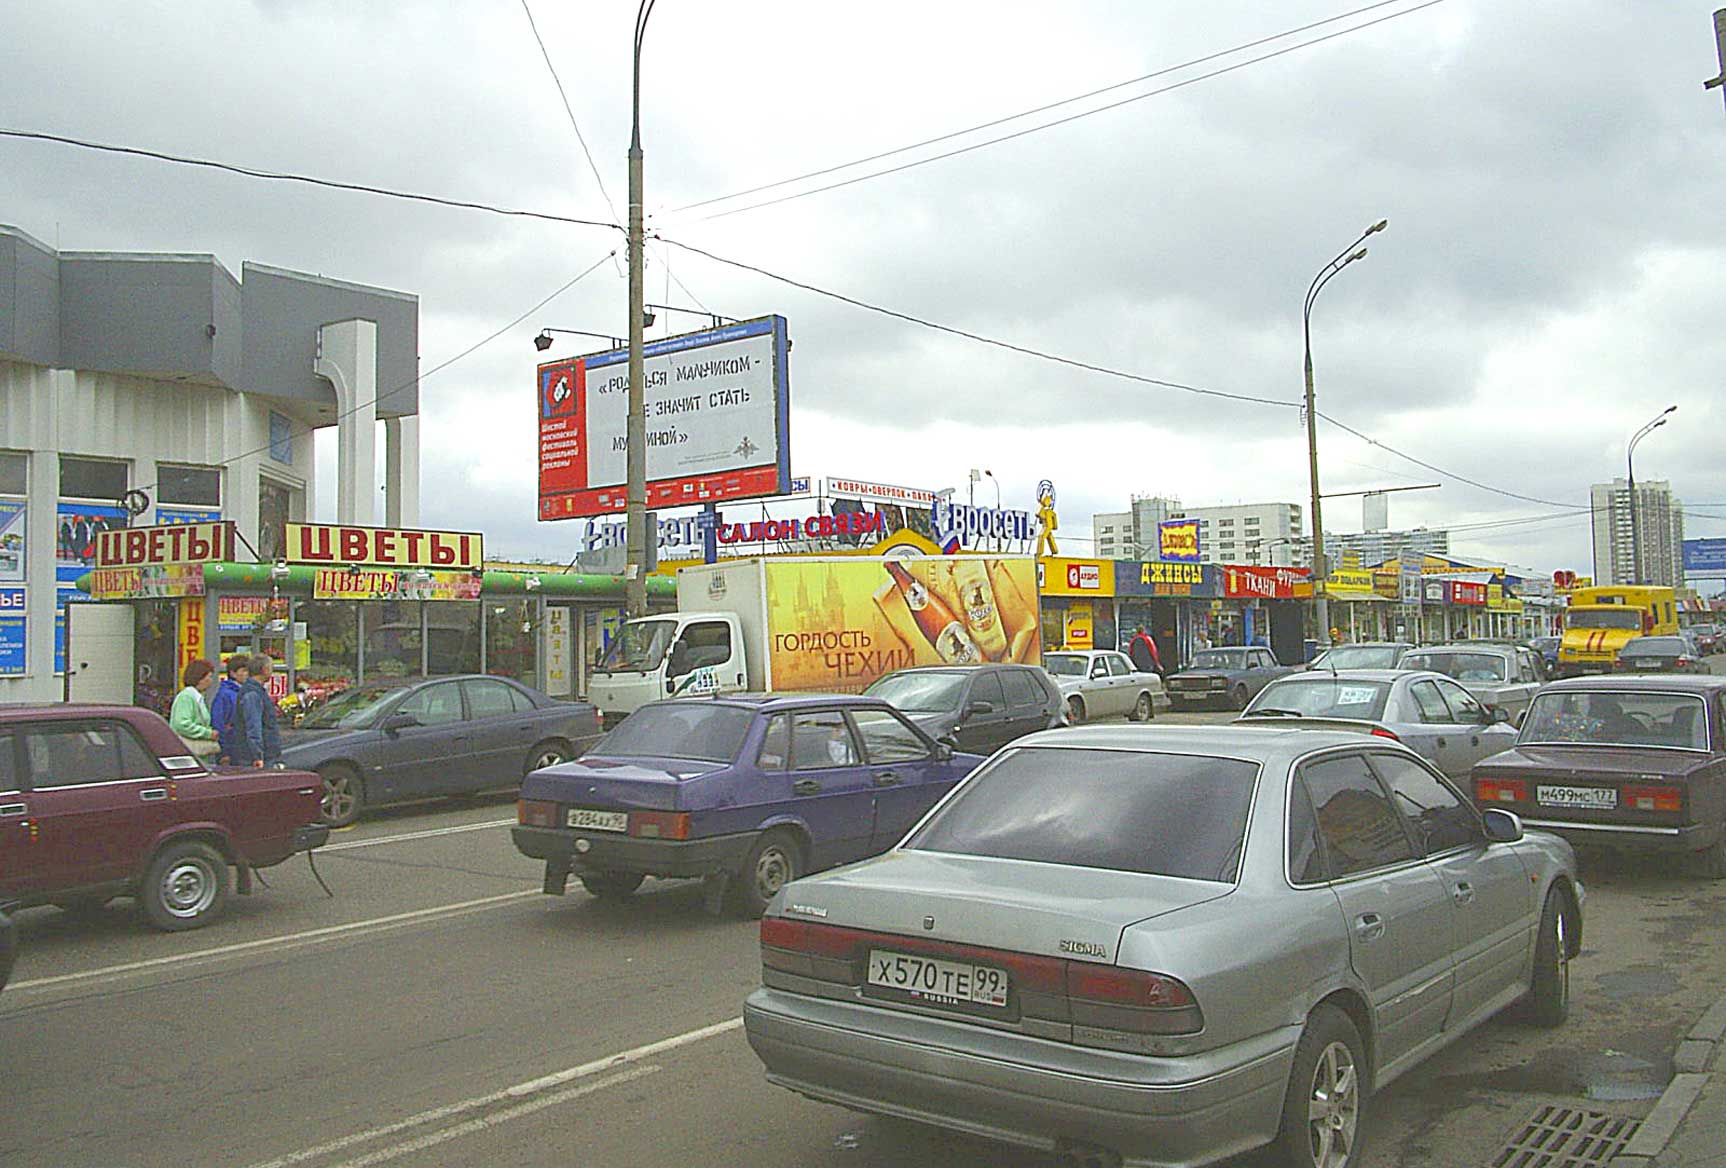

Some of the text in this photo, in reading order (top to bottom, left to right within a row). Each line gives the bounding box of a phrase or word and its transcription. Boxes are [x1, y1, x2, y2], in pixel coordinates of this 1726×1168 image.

[676, 356, 750, 381] МАЛЬЧИКОМ
[656, 395, 702, 416] ЗНАЧИТ
[709, 388, 750, 408] СТАТЬ
[837, 481, 868, 493] КОВРЫ
[717, 511, 886, 544] САЛОН СВЯЗИ
[101, 525, 221, 566] ЦВЕТЫ
[300, 526, 470, 566] ЦВЕТЫ
[94, 567, 143, 595] ЦВЕТЫ
[320, 570, 399, 594] ЦВЕТЫ
[1141, 563, 1203, 584] ДЖИНСЫ
[1245, 572, 1276, 598] ТКАНИ
[775, 630, 872, 653] ГОРДОСТЬ
[824, 648, 916, 678] ЧЕХИИ
[1059, 939, 1107, 958] SIGMA
[976, 968, 999, 993] 99
